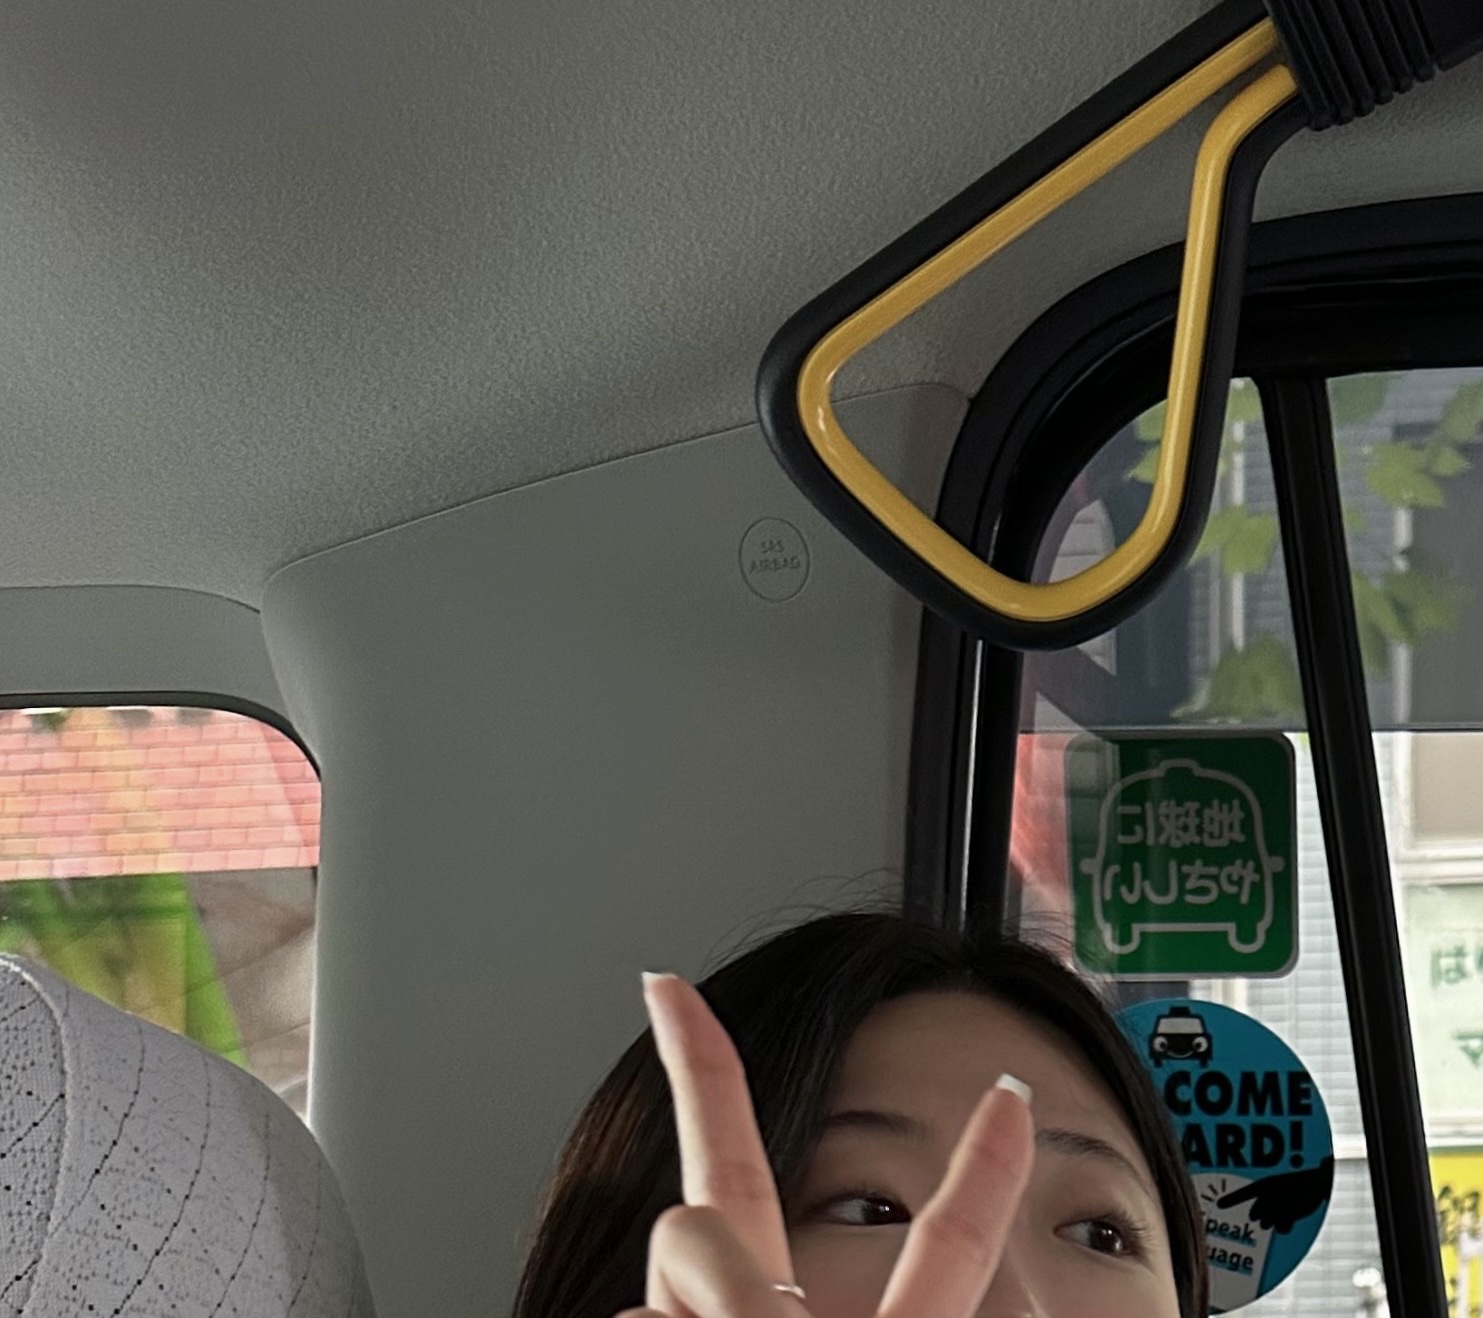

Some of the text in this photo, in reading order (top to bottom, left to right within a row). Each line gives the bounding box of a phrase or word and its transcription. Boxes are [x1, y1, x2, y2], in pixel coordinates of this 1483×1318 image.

[1163, 1069, 1313, 1117] COME
[1182, 1122, 1305, 1169] ARD!
[1203, 1215, 1256, 1243] peak
